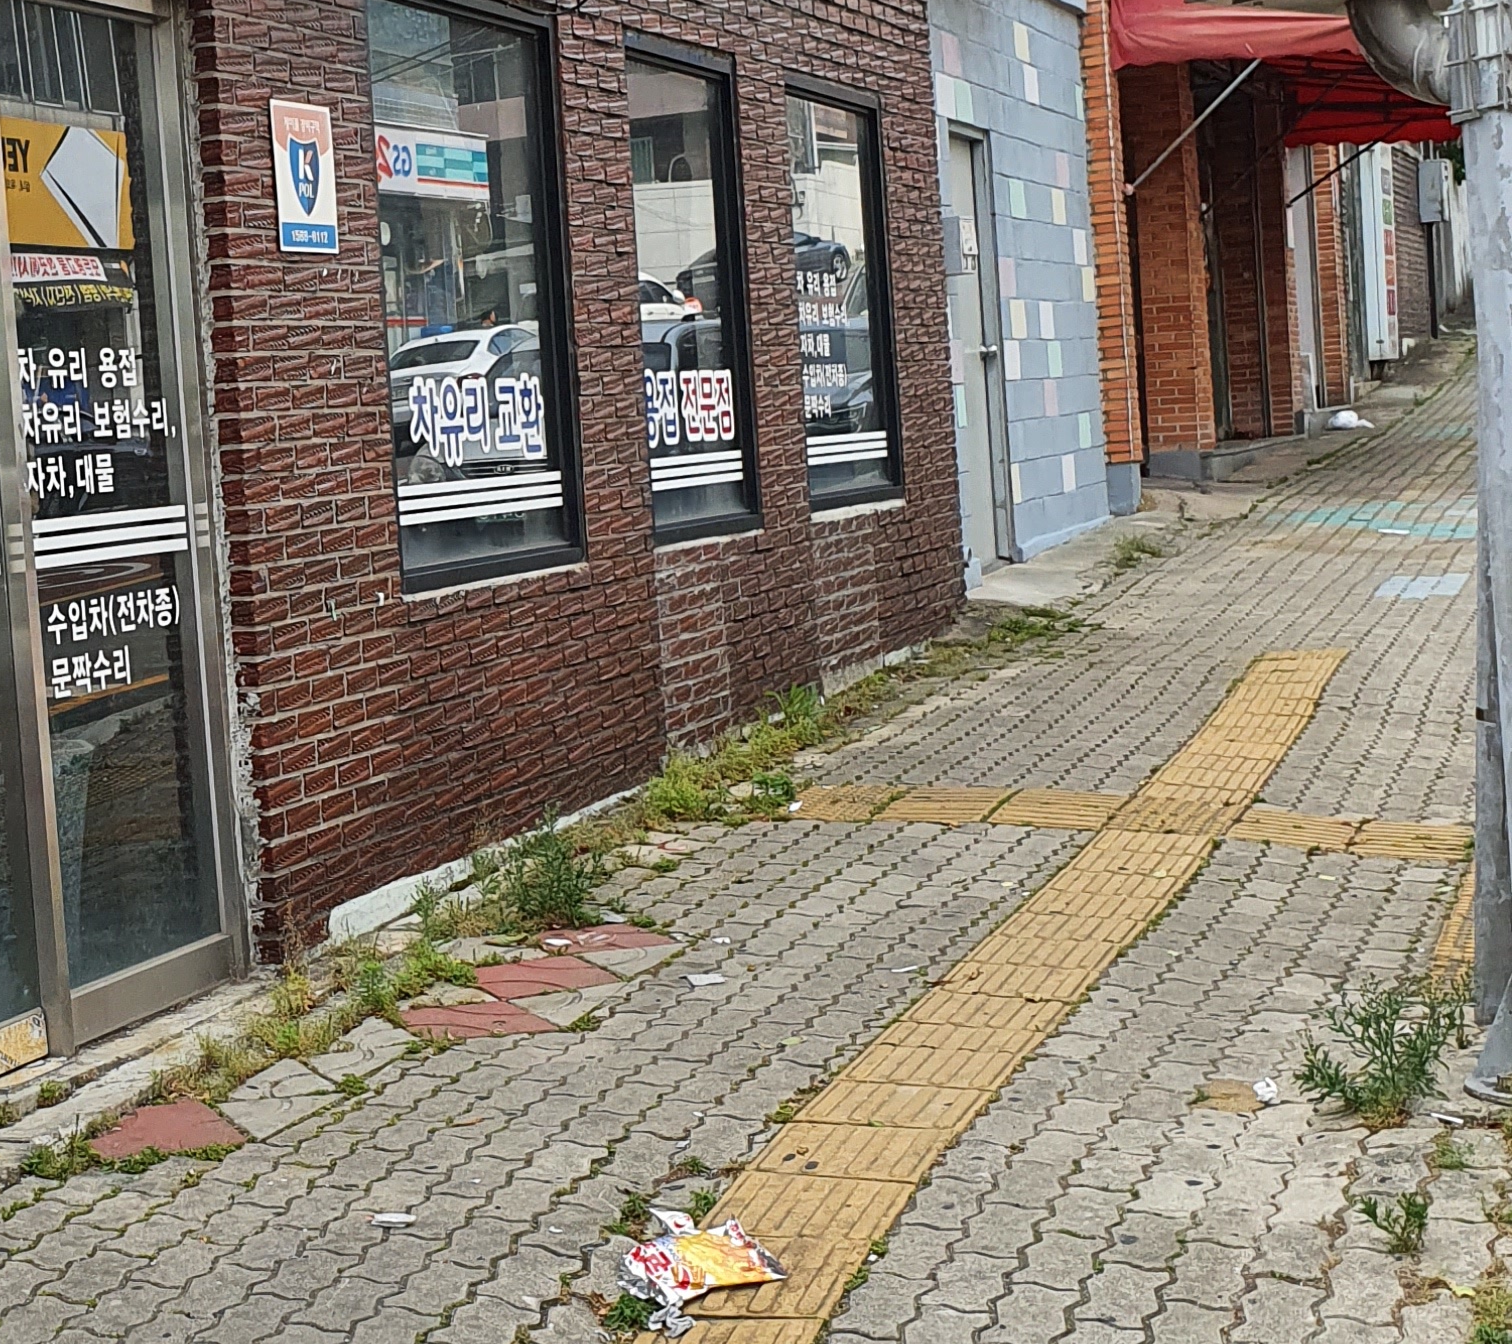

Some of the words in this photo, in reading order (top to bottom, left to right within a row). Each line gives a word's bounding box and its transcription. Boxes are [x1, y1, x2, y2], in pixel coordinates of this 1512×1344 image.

[47, 347, 88, 389] 유리
[98, 347, 138, 388] 용접
[408, 375, 491, 468] 차유리
[494, 372, 545, 460] 교환
[679, 368, 735, 443] 전문점
[46, 585, 181, 646] 수입차(전차종)
[50, 644, 134, 701] 문짝수리
